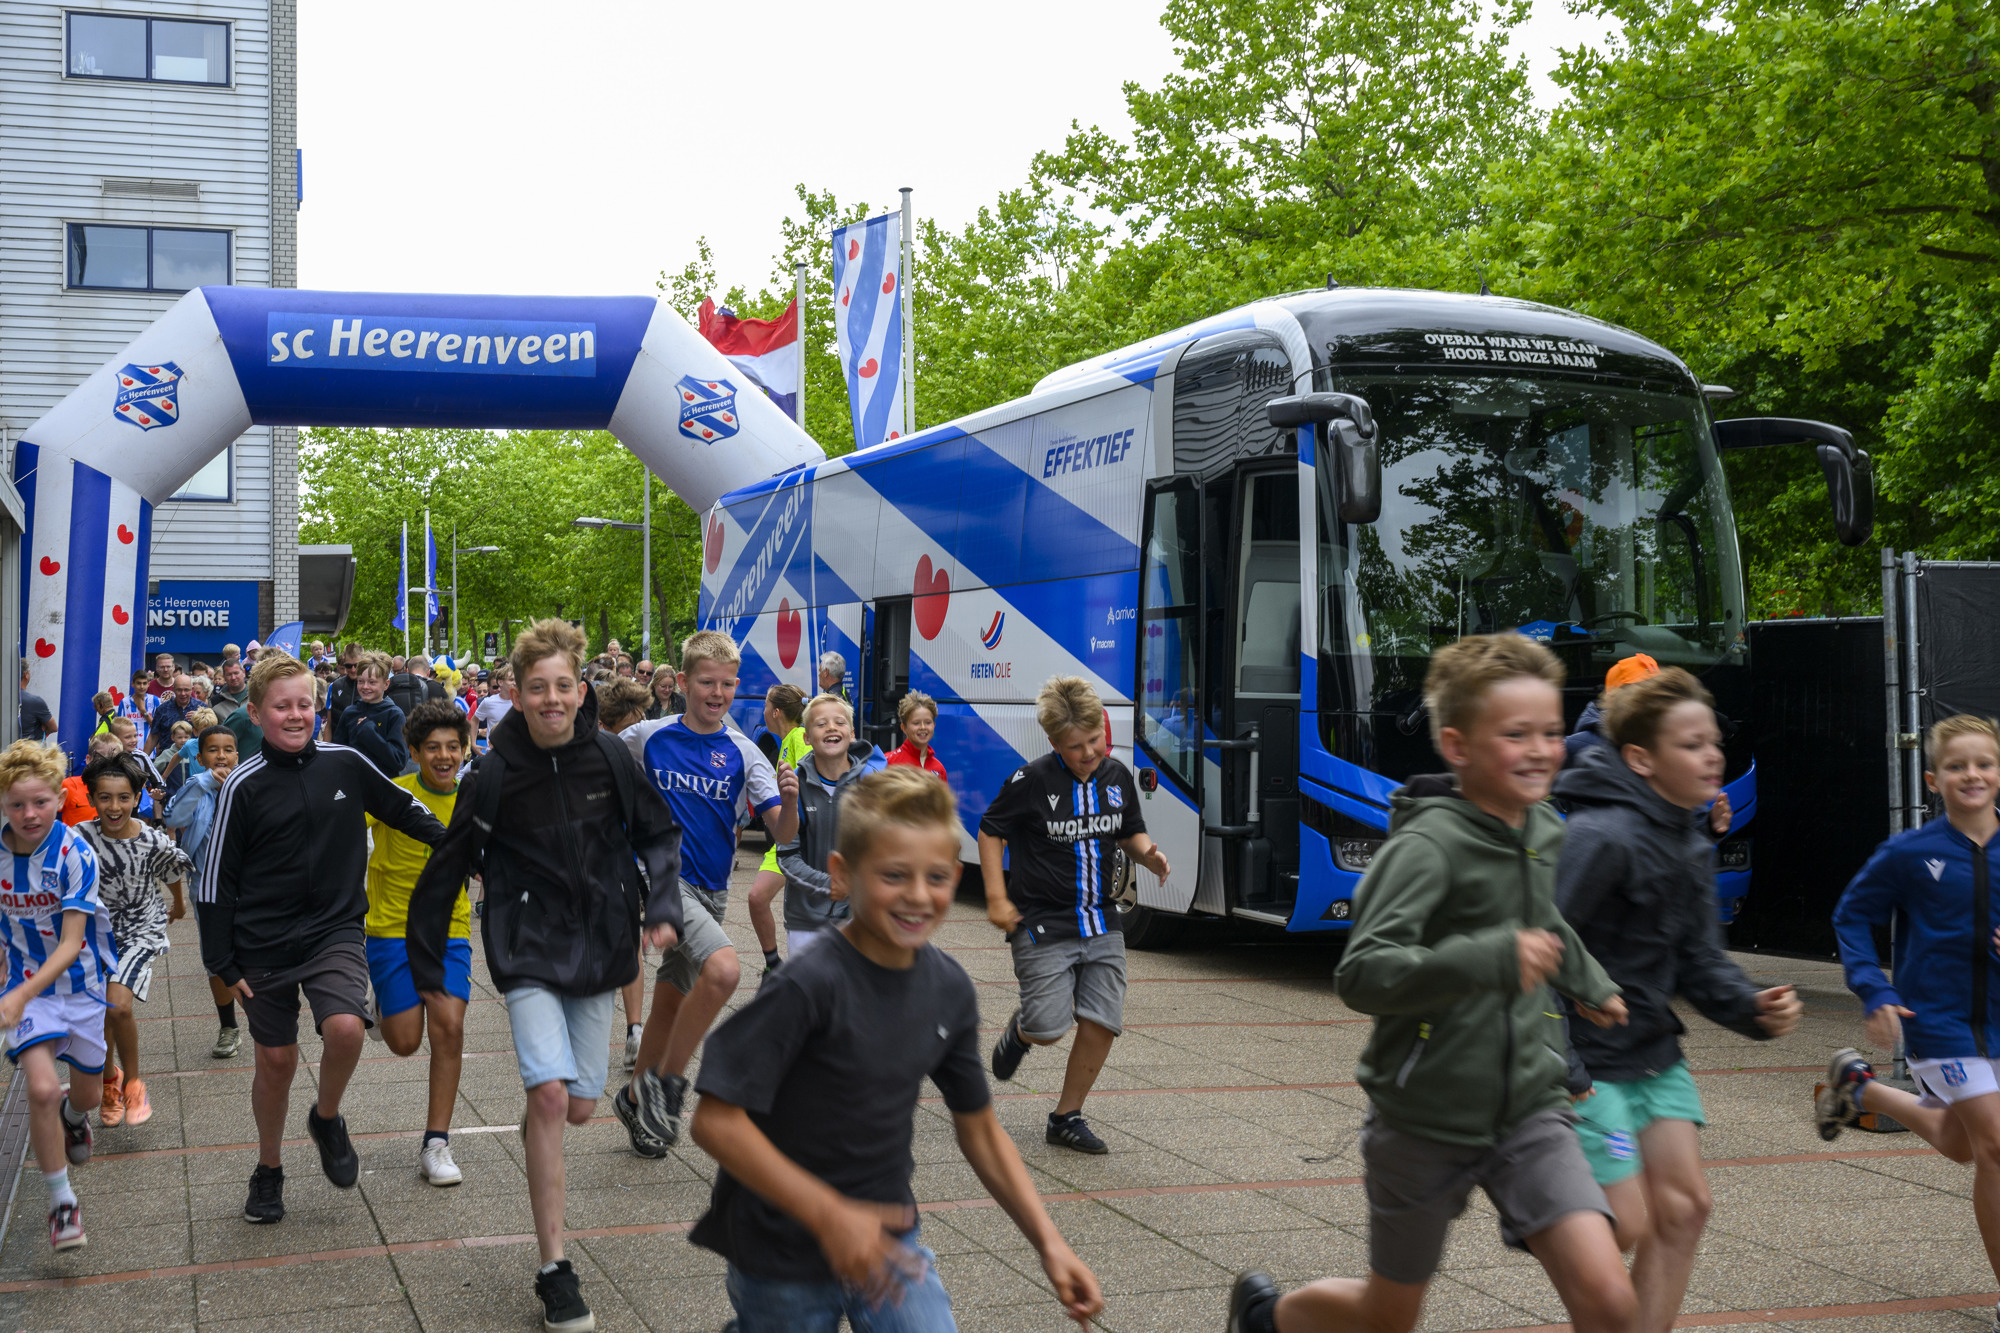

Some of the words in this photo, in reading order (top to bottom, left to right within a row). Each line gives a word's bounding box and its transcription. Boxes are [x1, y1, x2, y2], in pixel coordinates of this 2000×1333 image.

[271, 329, 315, 363] sc
[328, 318, 596, 366] Heerenveen
[1424, 333, 1485, 347] OVERAL
[1484, 336, 1531, 349] WAAR
[1530, 339, 1557, 352] WE
[1557, 341, 1605, 358] GAAN,
[1443, 347, 1488, 361] HOOR
[1489, 349, 1507, 362] JE
[1508, 350, 1550, 365] ONZE
[1550, 353, 1598, 369] NAAM
[119, 394, 128, 403] sc
[128, 384, 174, 399] Heerenveen
[683, 410, 692, 419] sc
[691, 398, 733, 415] Heerenveen
[1042, 428, 1135, 479] EFFEKTIEF
[715, 471, 806, 637] Heerenveen
[148, 599, 162, 608] sc
[164, 596, 230, 608] Heerenveen
[146, 609, 230, 627] NSTORE
[1096, 639, 1116, 649] macron
[653, 768, 731, 801] UNIVÉ
[0, 892, 61, 908] OLKO
